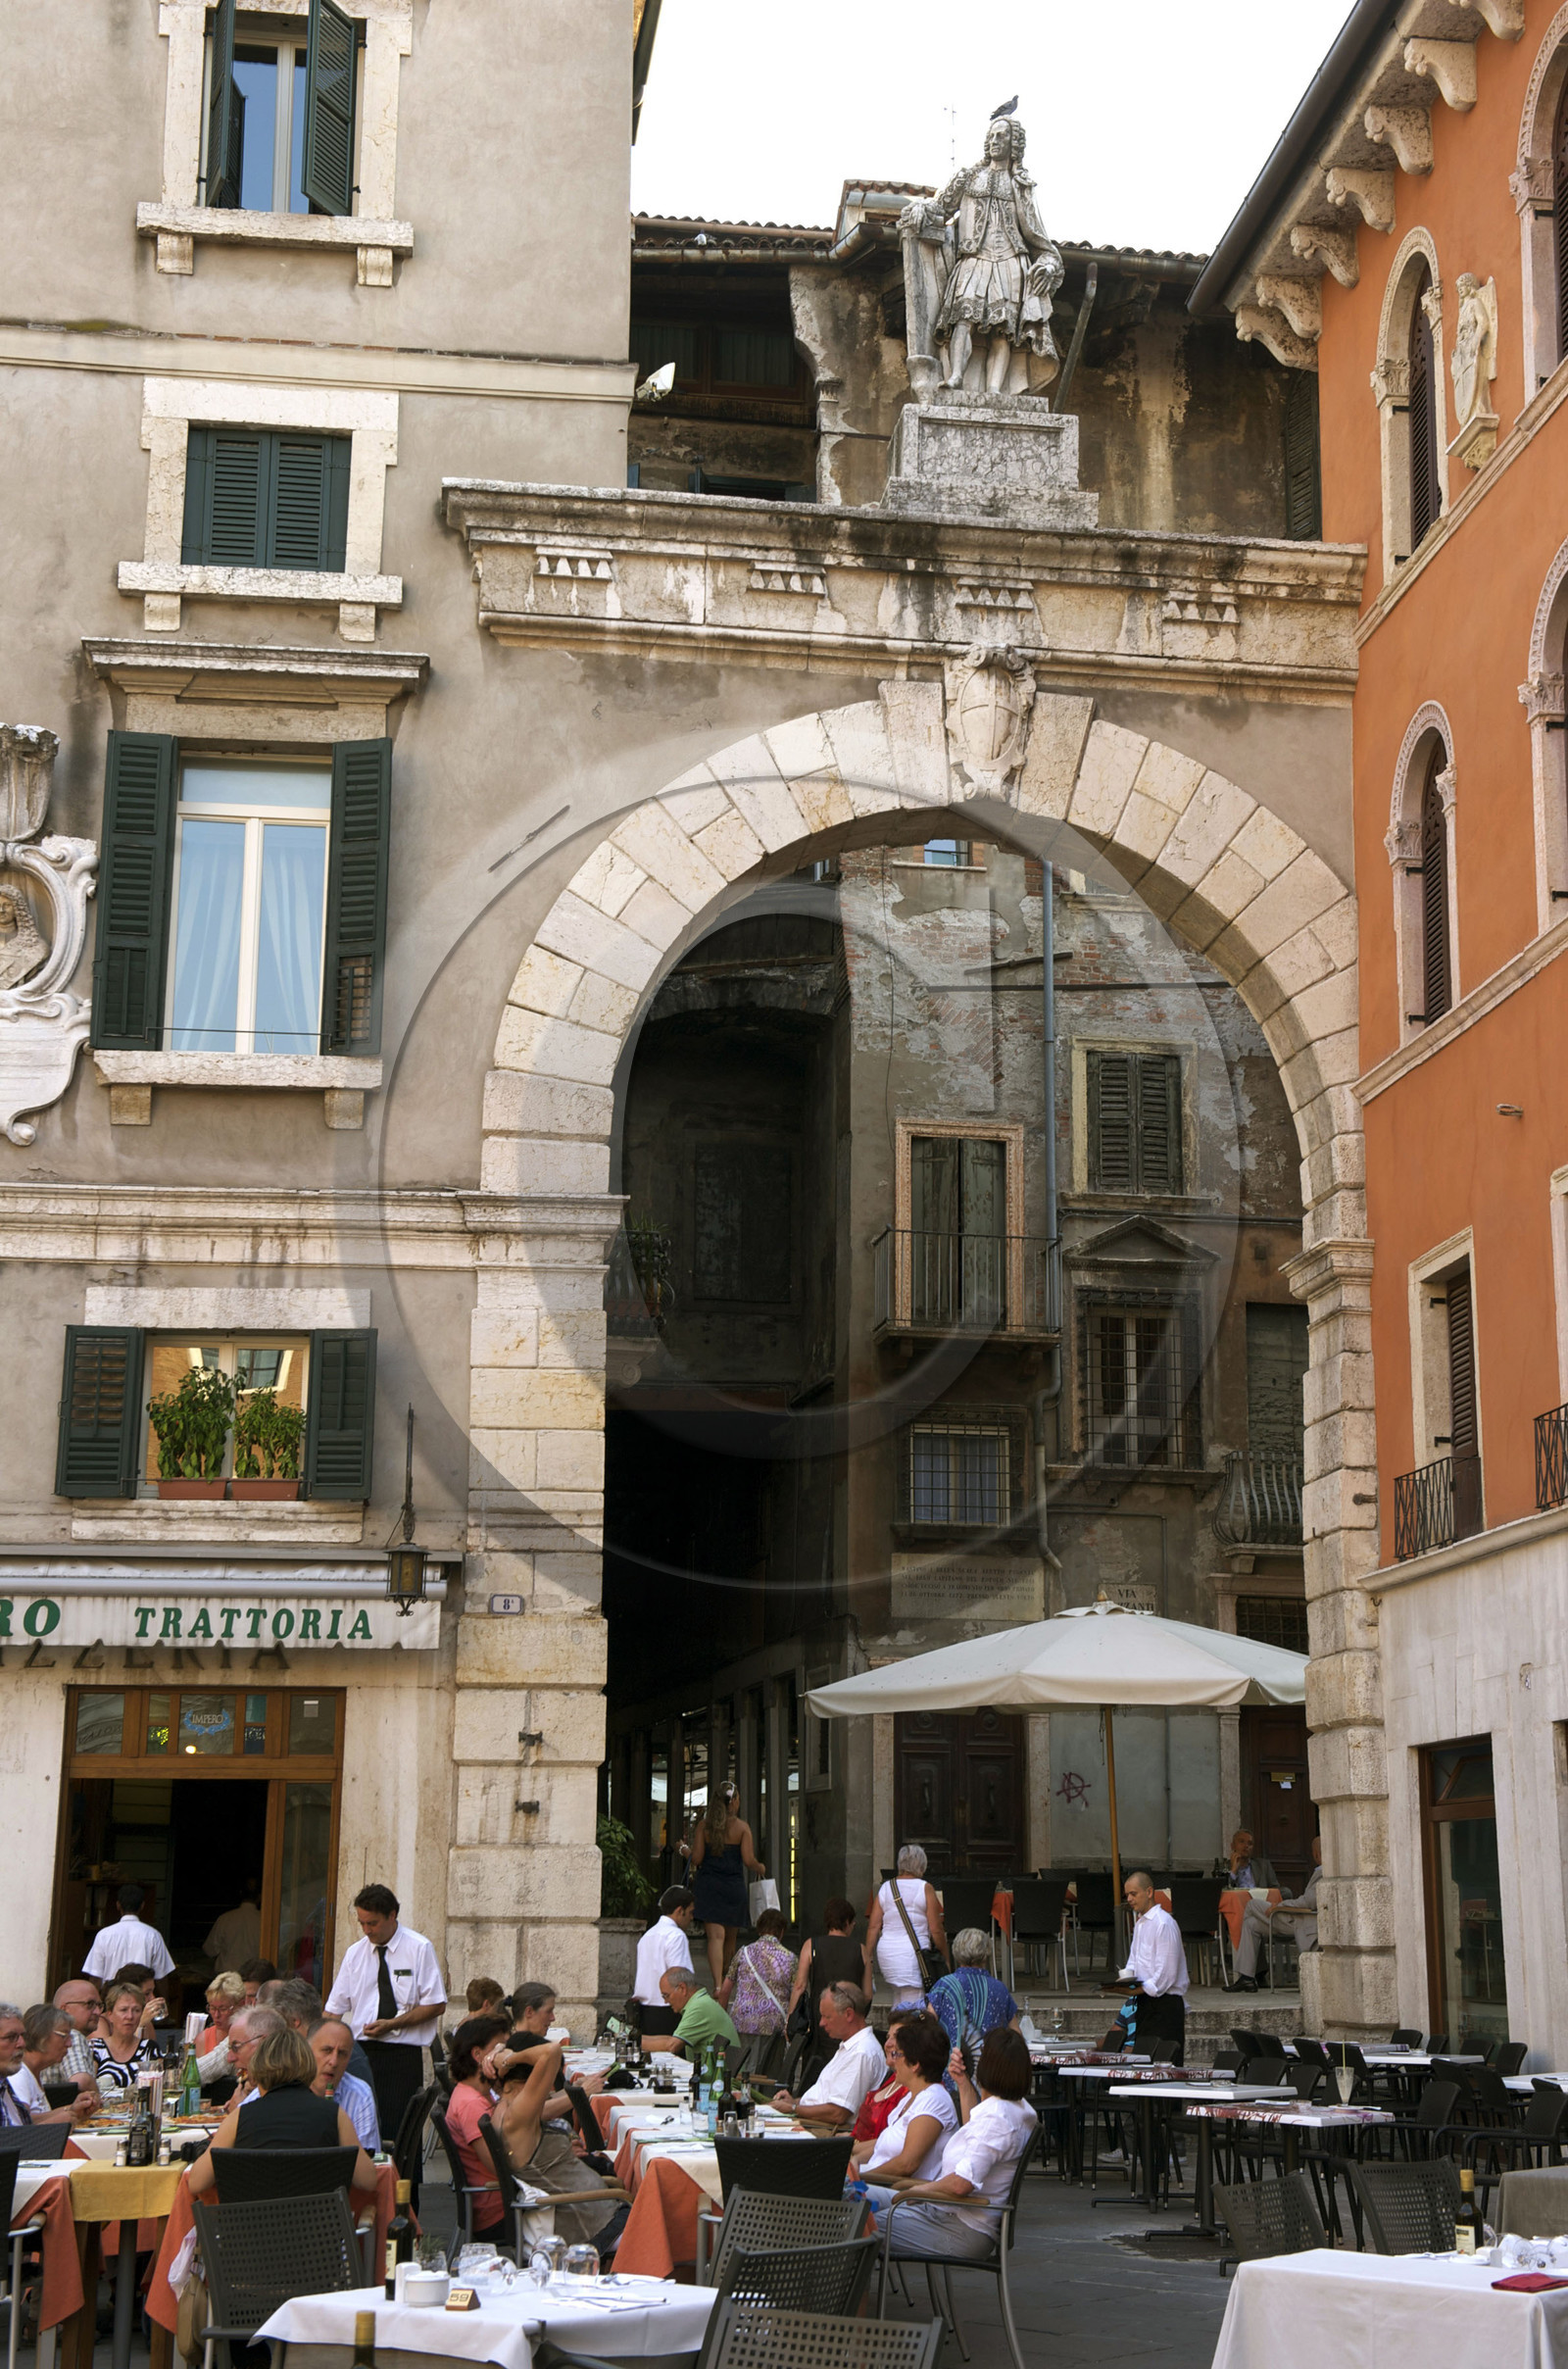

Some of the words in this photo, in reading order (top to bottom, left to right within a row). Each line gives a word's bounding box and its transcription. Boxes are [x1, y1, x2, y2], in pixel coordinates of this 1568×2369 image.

[1117, 1589, 1137, 1599] VIA
[134, 1607, 372, 1639] TRATTORIA
[0, 1642, 290, 1670] ZZERIA
[192, 1713, 224, 1724] IMPERO
[450, 2293, 469, 2302] 59
